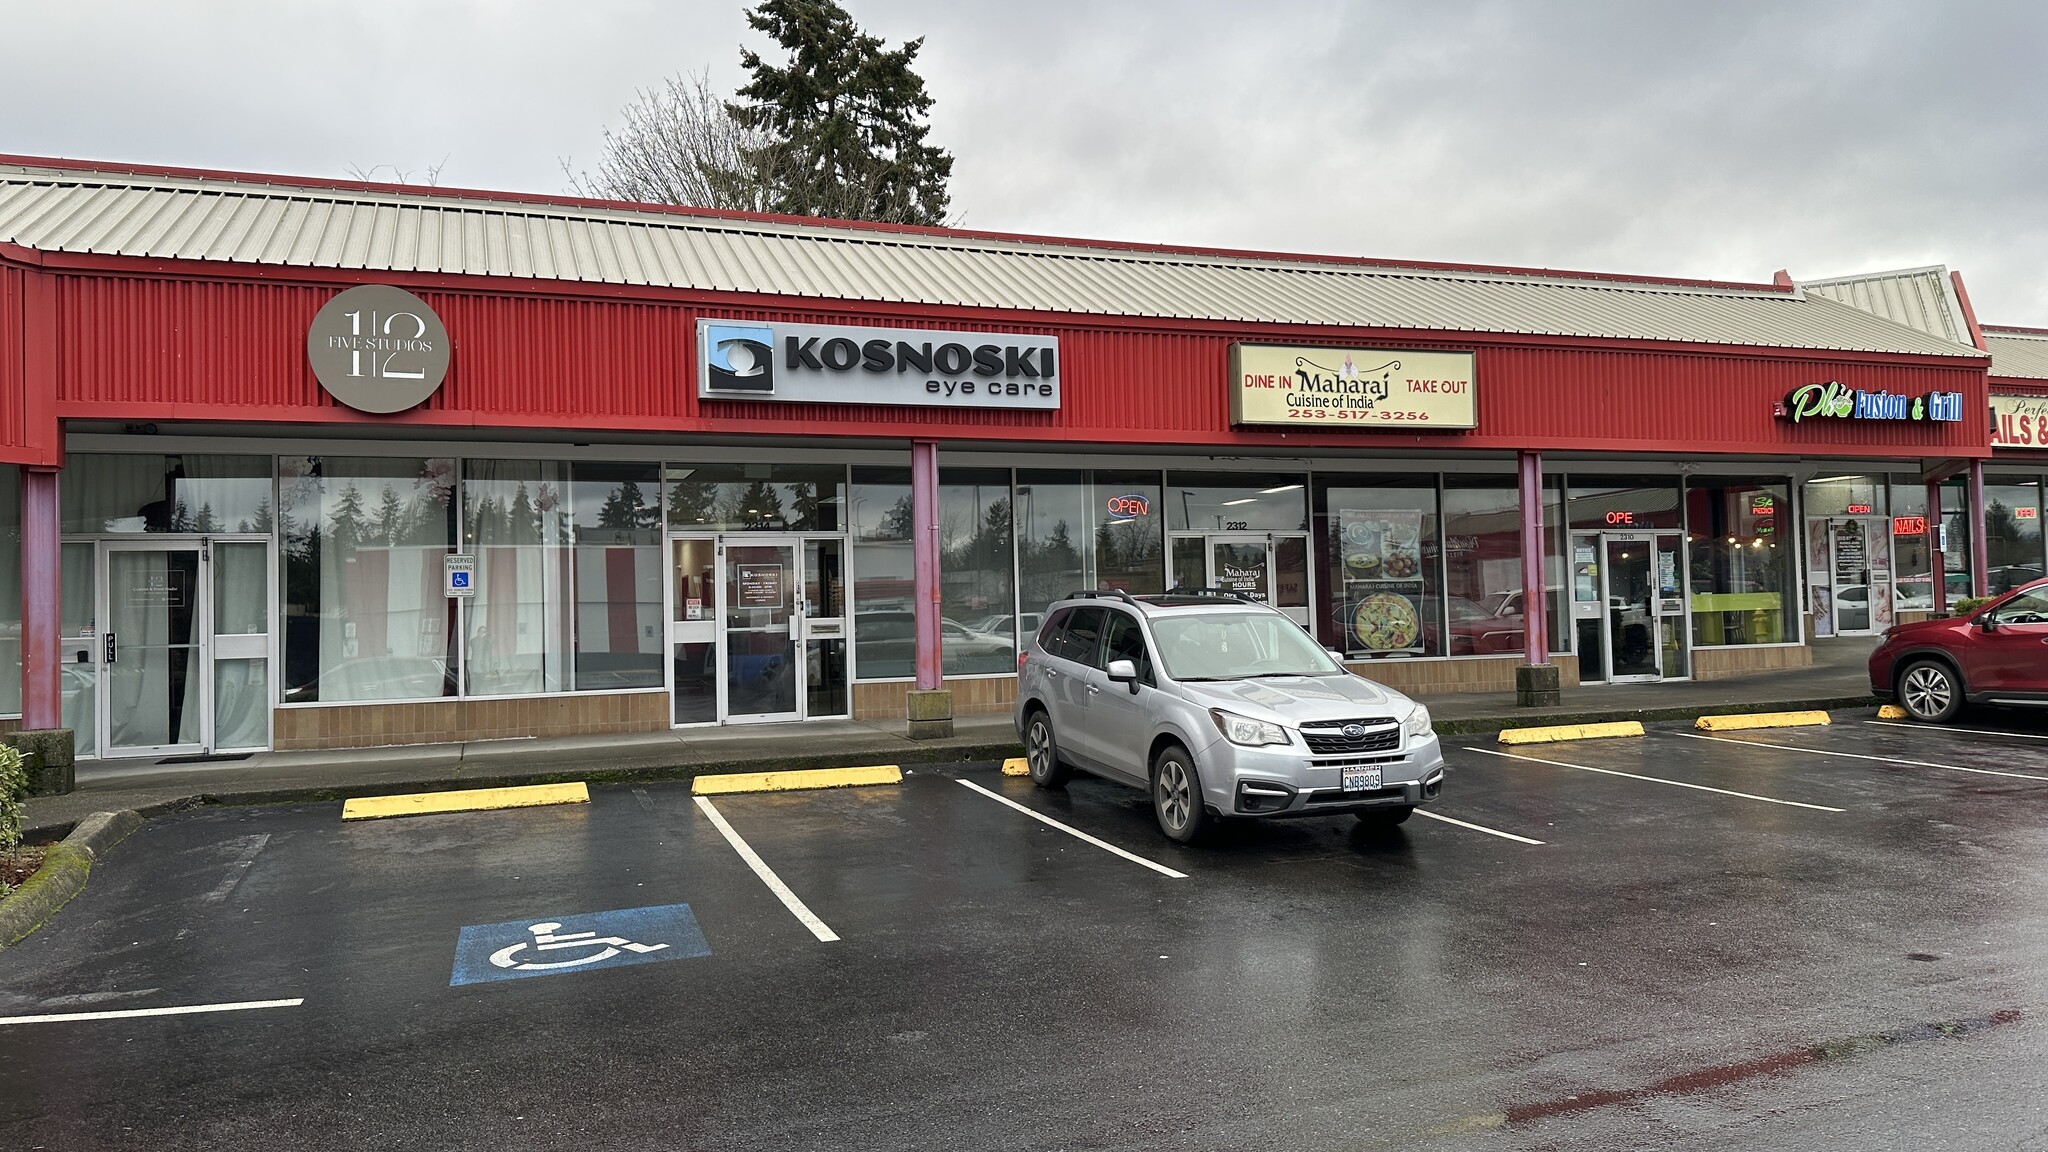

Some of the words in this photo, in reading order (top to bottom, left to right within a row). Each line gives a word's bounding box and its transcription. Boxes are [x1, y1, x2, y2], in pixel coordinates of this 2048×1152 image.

[328, 336, 363, 350] FIVE
[365, 337, 432, 353] STUDIOS
[785, 335, 1055, 378] KOSNOSKI
[926, 380, 976, 397] eye
[988, 382, 1053, 397] care
[1244, 374, 1275, 389] DINE
[1279, 376, 1292, 389] IN
[1295, 368, 1390, 403] Maharaj
[1406, 379, 1438, 394] TAKE
[1441, 380, 1467, 394] OUT
[1286, 392, 1330, 408] Cuisine
[1332, 394, 1345, 408] of
[1346, 395, 1375, 409] India
[1854, 389, 1907, 420] Fusion
[1911, 396, 1924, 421] &
[1928, 390, 1963, 422] Grill
[1288, 408, 1430, 421] 253-517-3256
[1107, 497, 1148, 515] OPEN
[1848, 505, 1871, 513] OPEN
[744, 521, 770, 530] 2314
[1226, 521, 1247, 530] 2312
[1896, 519, 1923, 533] NAILS
[1620, 533, 1634, 541] 2310
[1224, 568, 1261, 579] Maharaj
[1344, 775, 1379, 788] CNB9809
